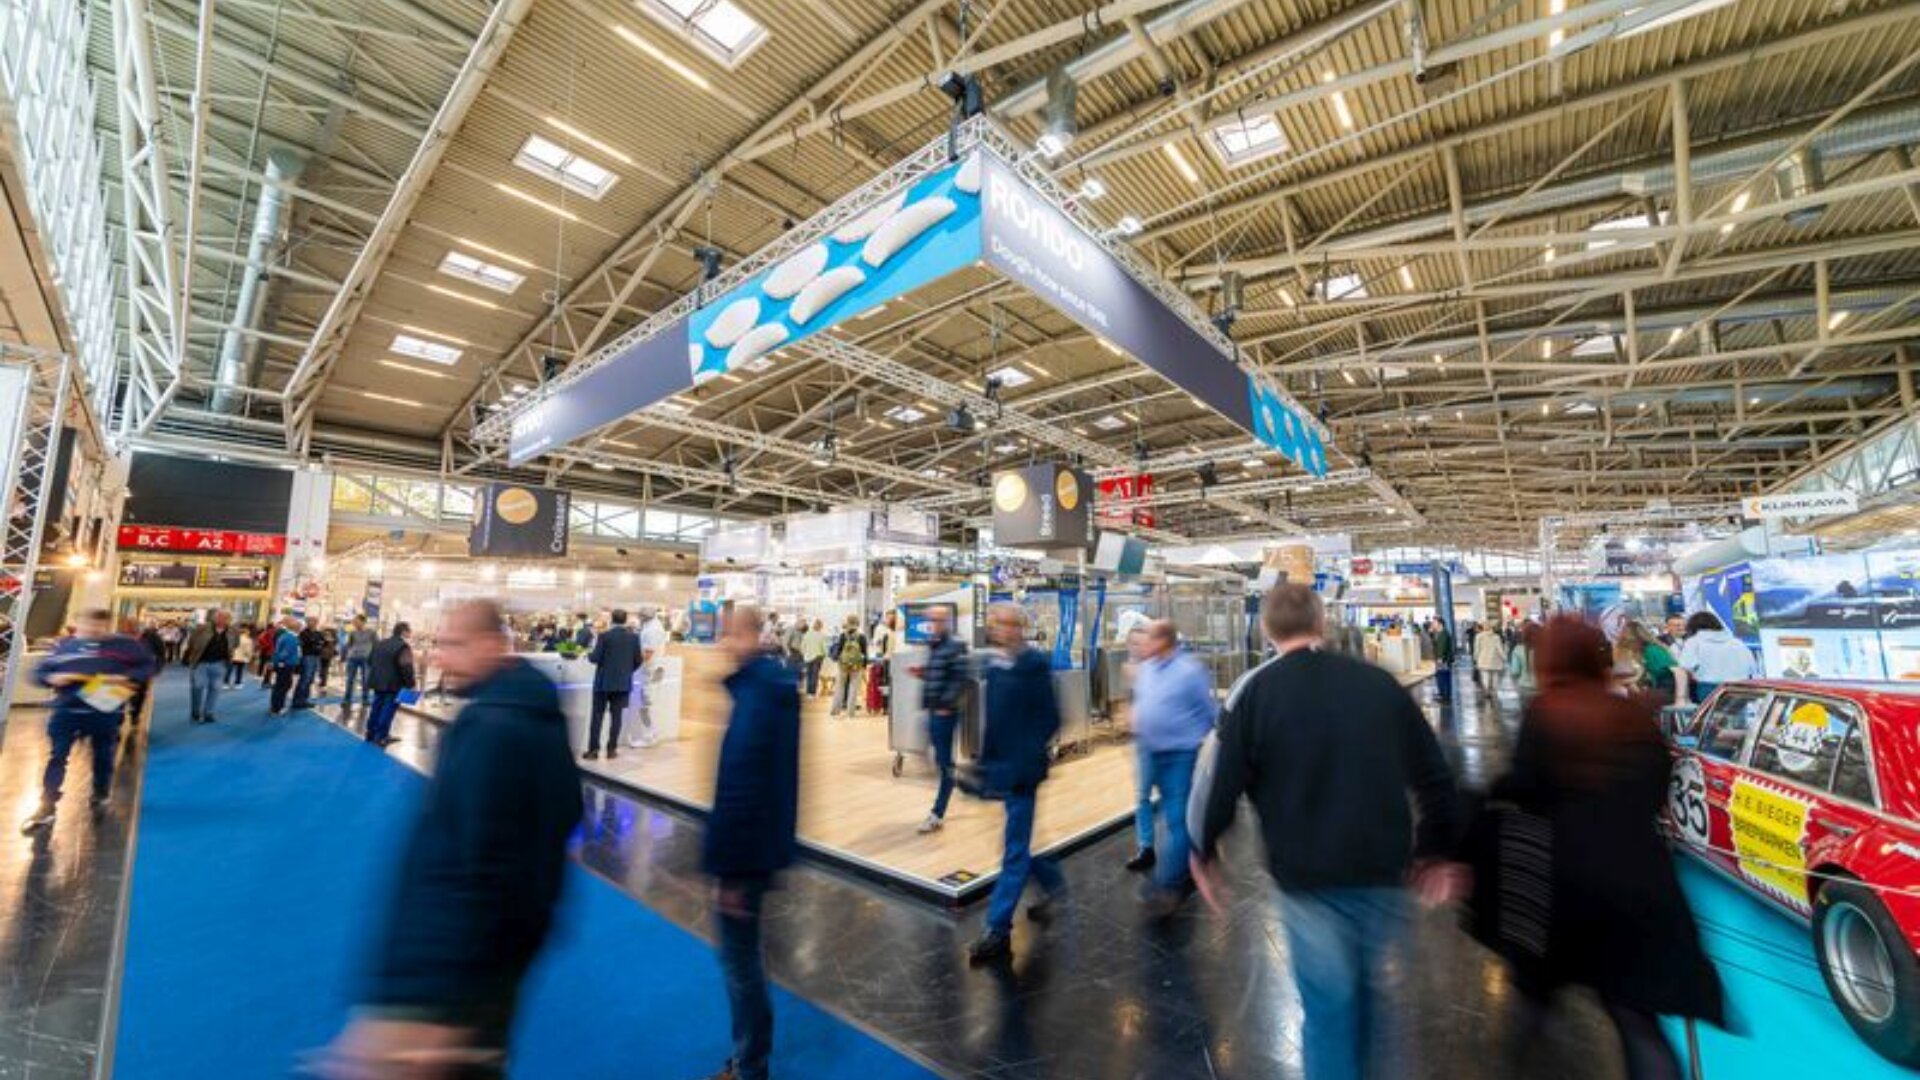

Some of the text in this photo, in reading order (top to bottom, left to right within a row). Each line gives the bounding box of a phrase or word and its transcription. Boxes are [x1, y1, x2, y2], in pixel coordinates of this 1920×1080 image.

[551, 493, 567, 552] Croissant
[1761, 498, 1849, 511] KUMKAYA
[197, 537, 224, 550] A2
[1672, 775, 1707, 838] 35
